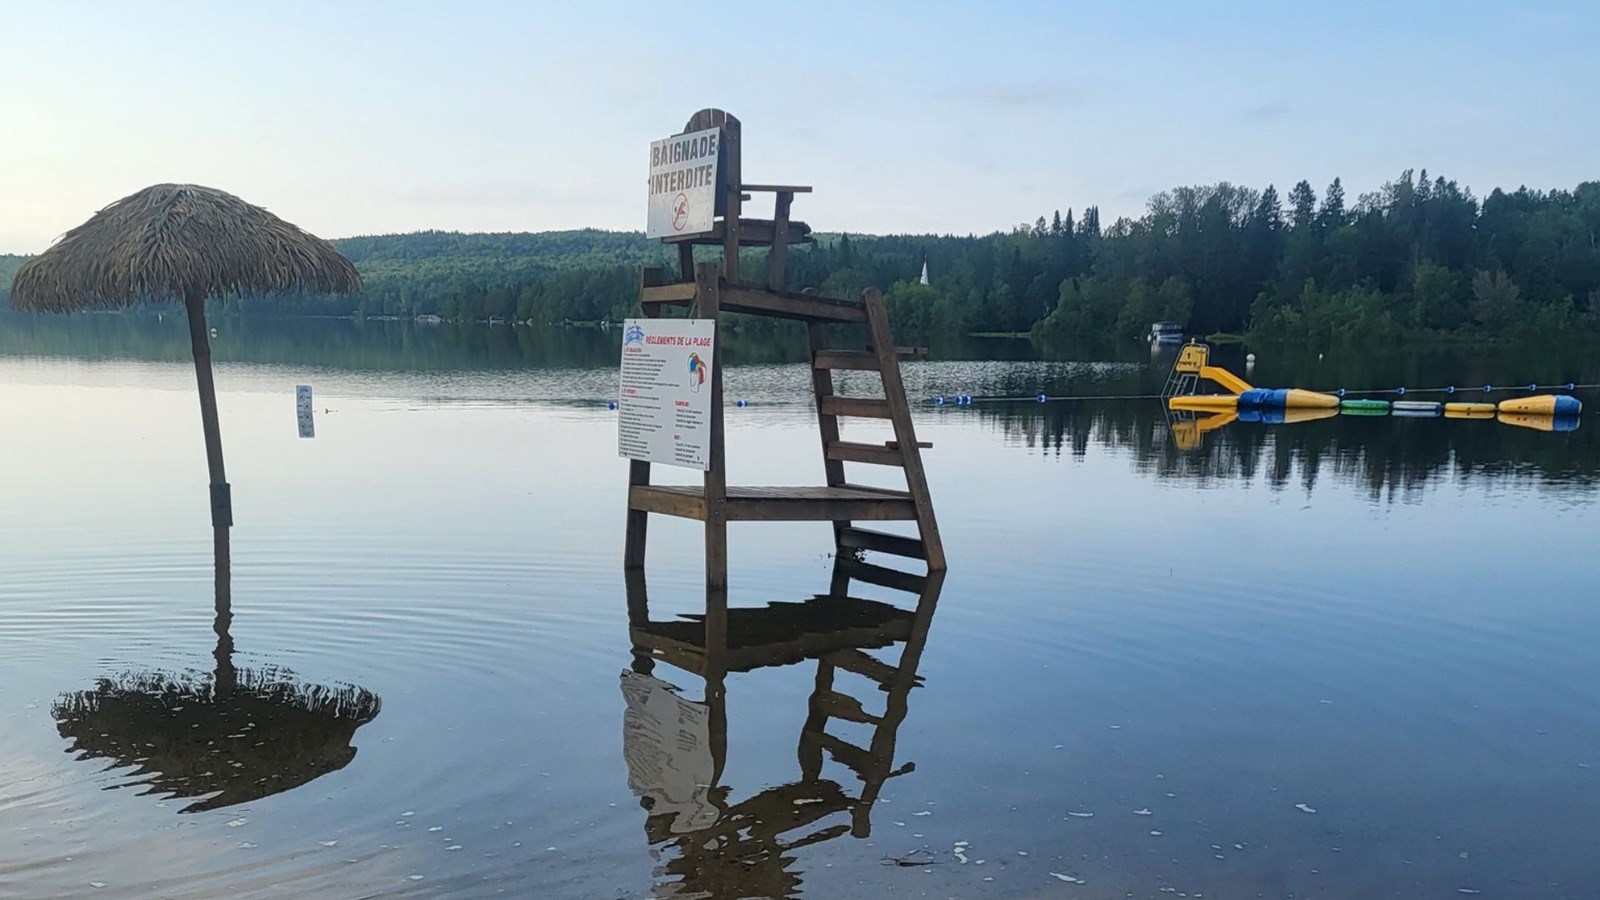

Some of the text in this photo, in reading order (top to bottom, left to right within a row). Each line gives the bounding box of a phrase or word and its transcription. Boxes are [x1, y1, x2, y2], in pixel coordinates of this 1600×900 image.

[653, 134, 716, 167] BAIGNADE
[651, 164, 713, 195] INTERDITE
[677, 337, 684, 346] DE
[685, 337, 692, 346] LA
[693, 337, 711, 347] PLAGE
